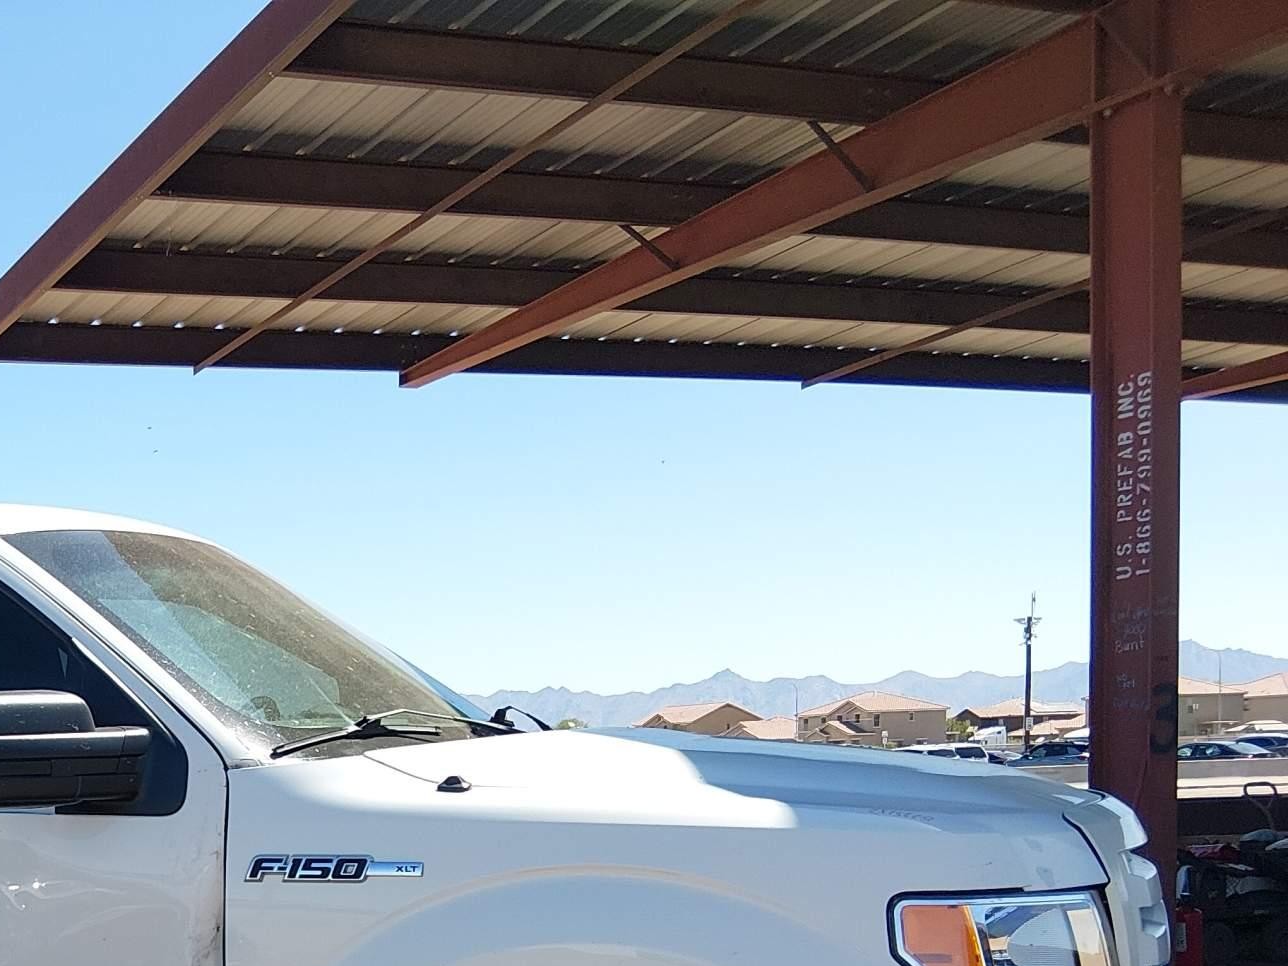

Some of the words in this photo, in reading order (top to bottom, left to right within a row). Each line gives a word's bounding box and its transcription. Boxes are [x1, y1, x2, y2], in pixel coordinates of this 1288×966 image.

[1117, 372, 1135, 419] INC.
[1116, 430, 1134, 523] PREFAB
[1136, 371, 1152, 579] 1-866-799-0969
[1115, 535, 1133, 580] U.S.
[246, 853, 372, 883] F-150
[395, 865, 418, 873] XLT
